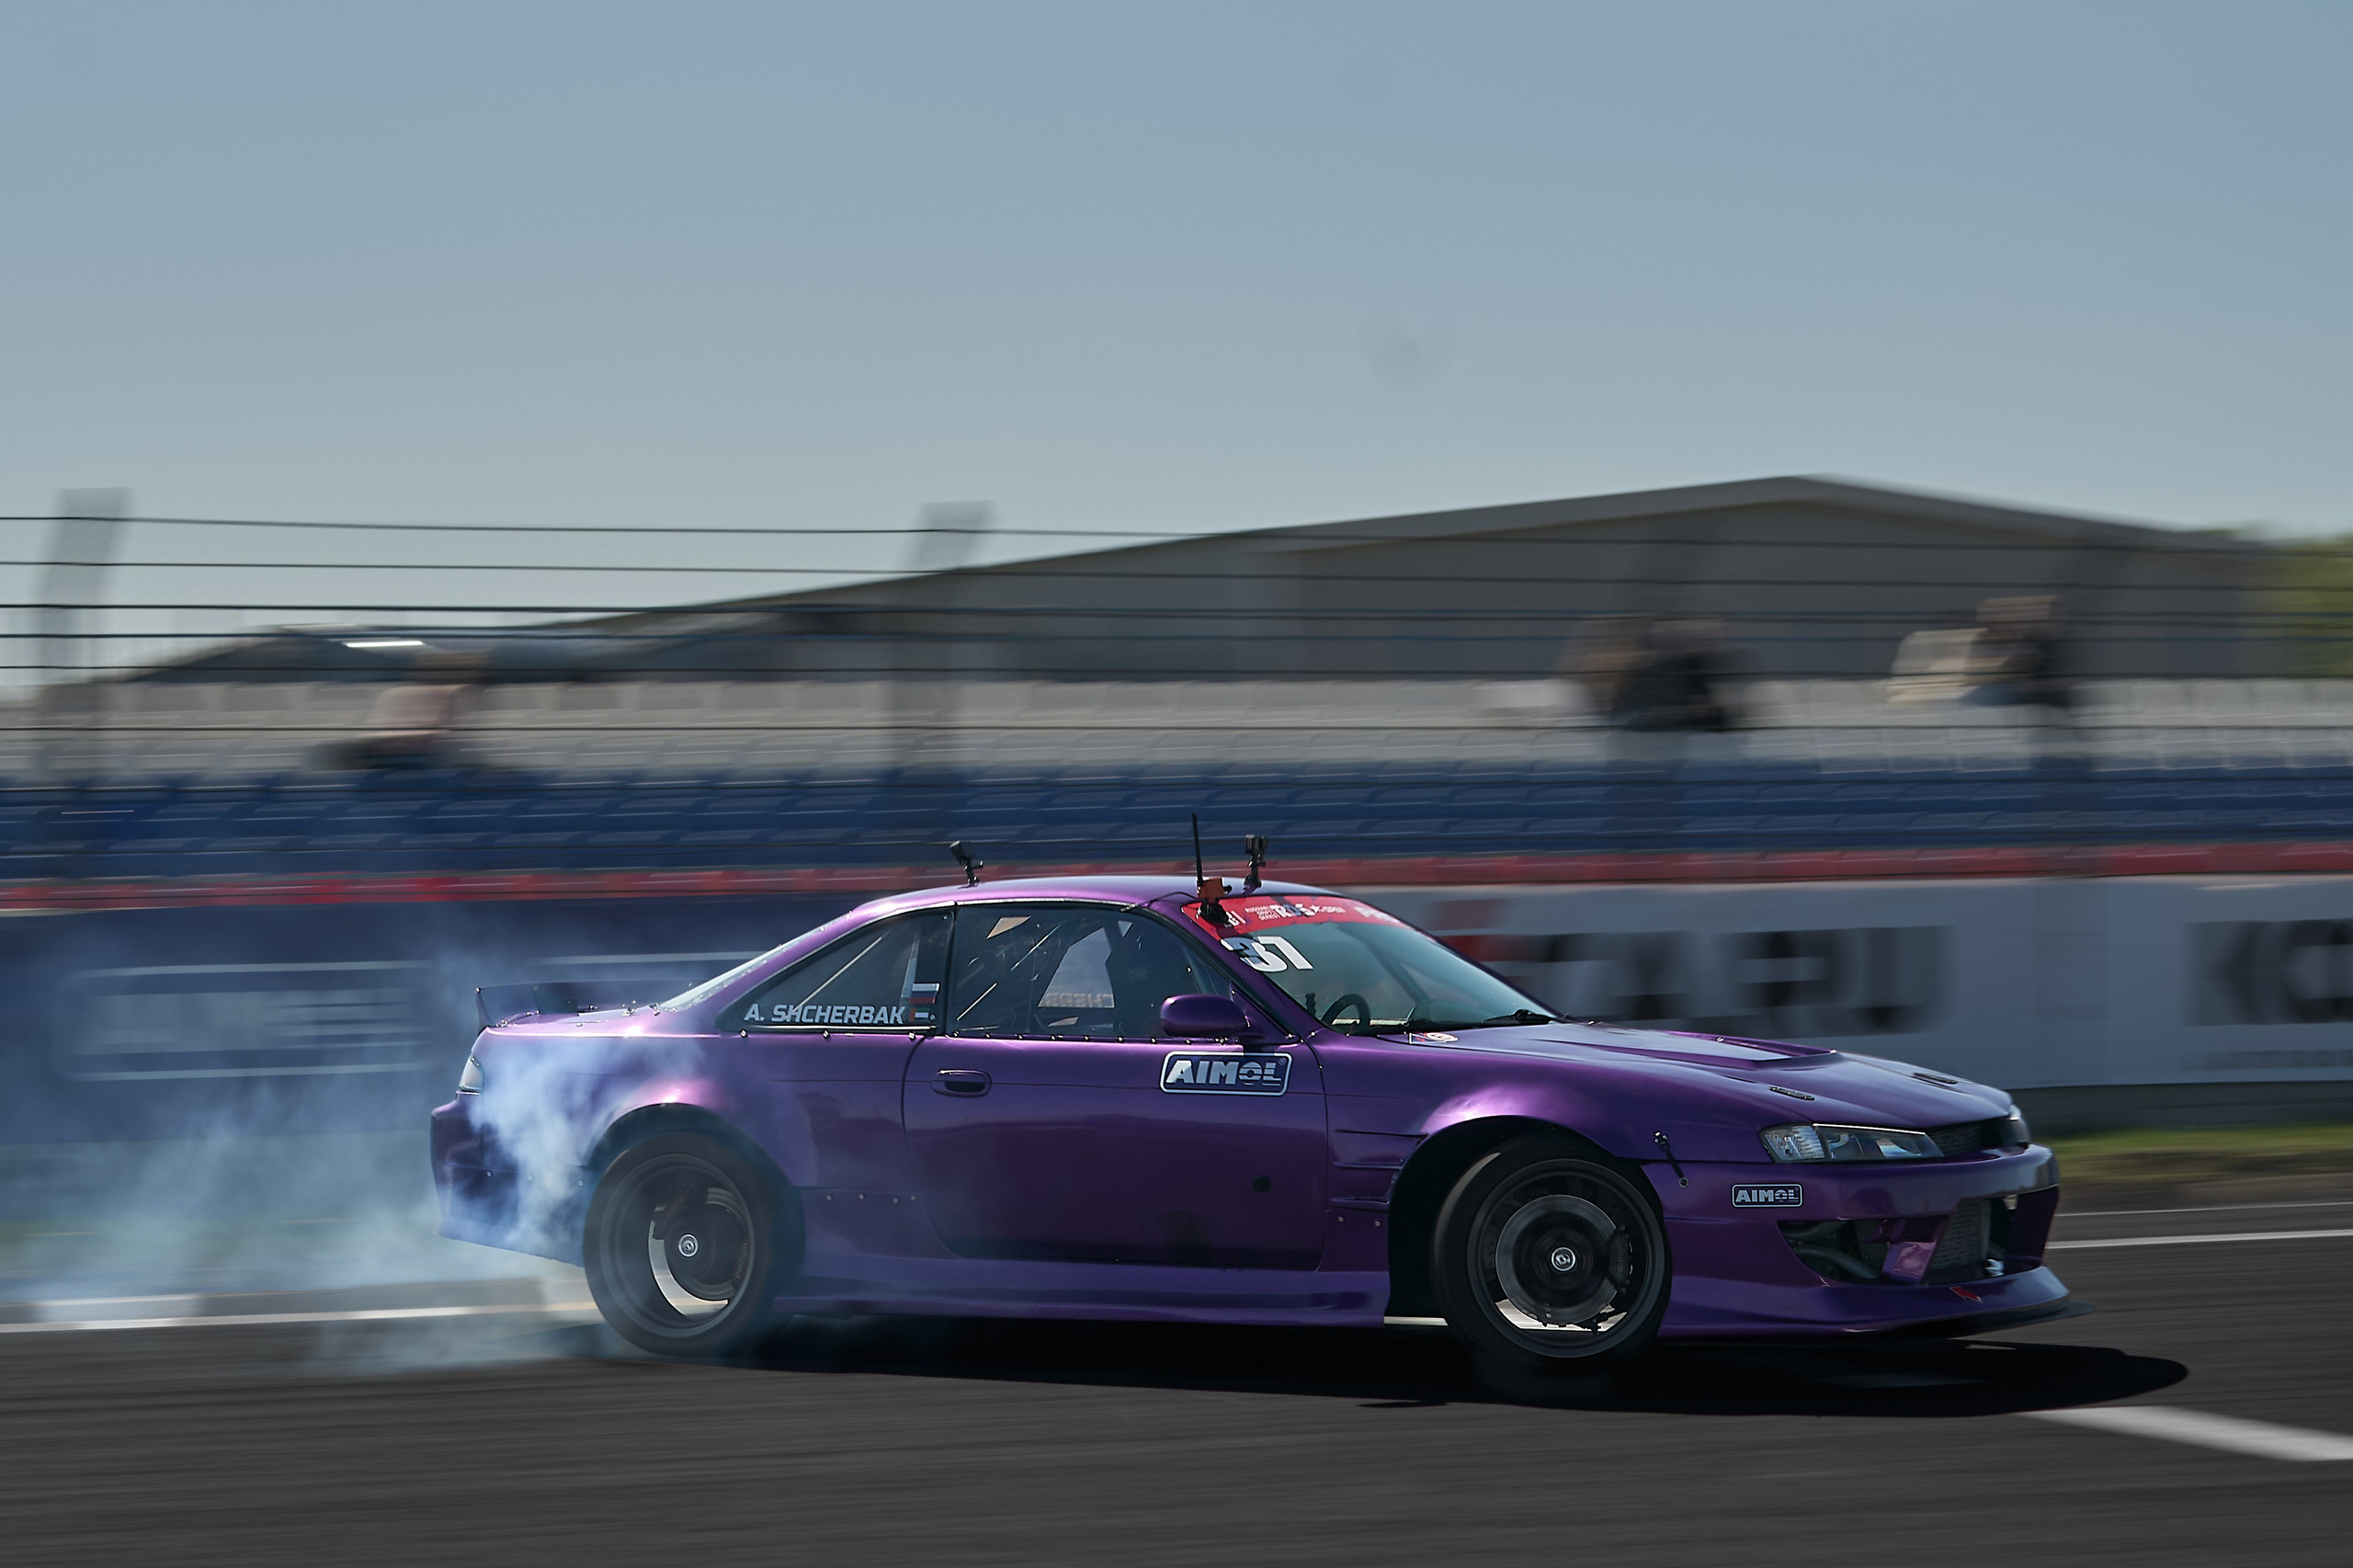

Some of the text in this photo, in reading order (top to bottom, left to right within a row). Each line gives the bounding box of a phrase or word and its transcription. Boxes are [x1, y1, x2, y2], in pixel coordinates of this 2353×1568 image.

[1220, 936, 1313, 971] 31
[744, 1004, 906, 1024] A. SHCHERBAK
[1165, 1060, 1282, 1086] AIMOL
[1735, 1189, 1799, 1203] AIMOL
